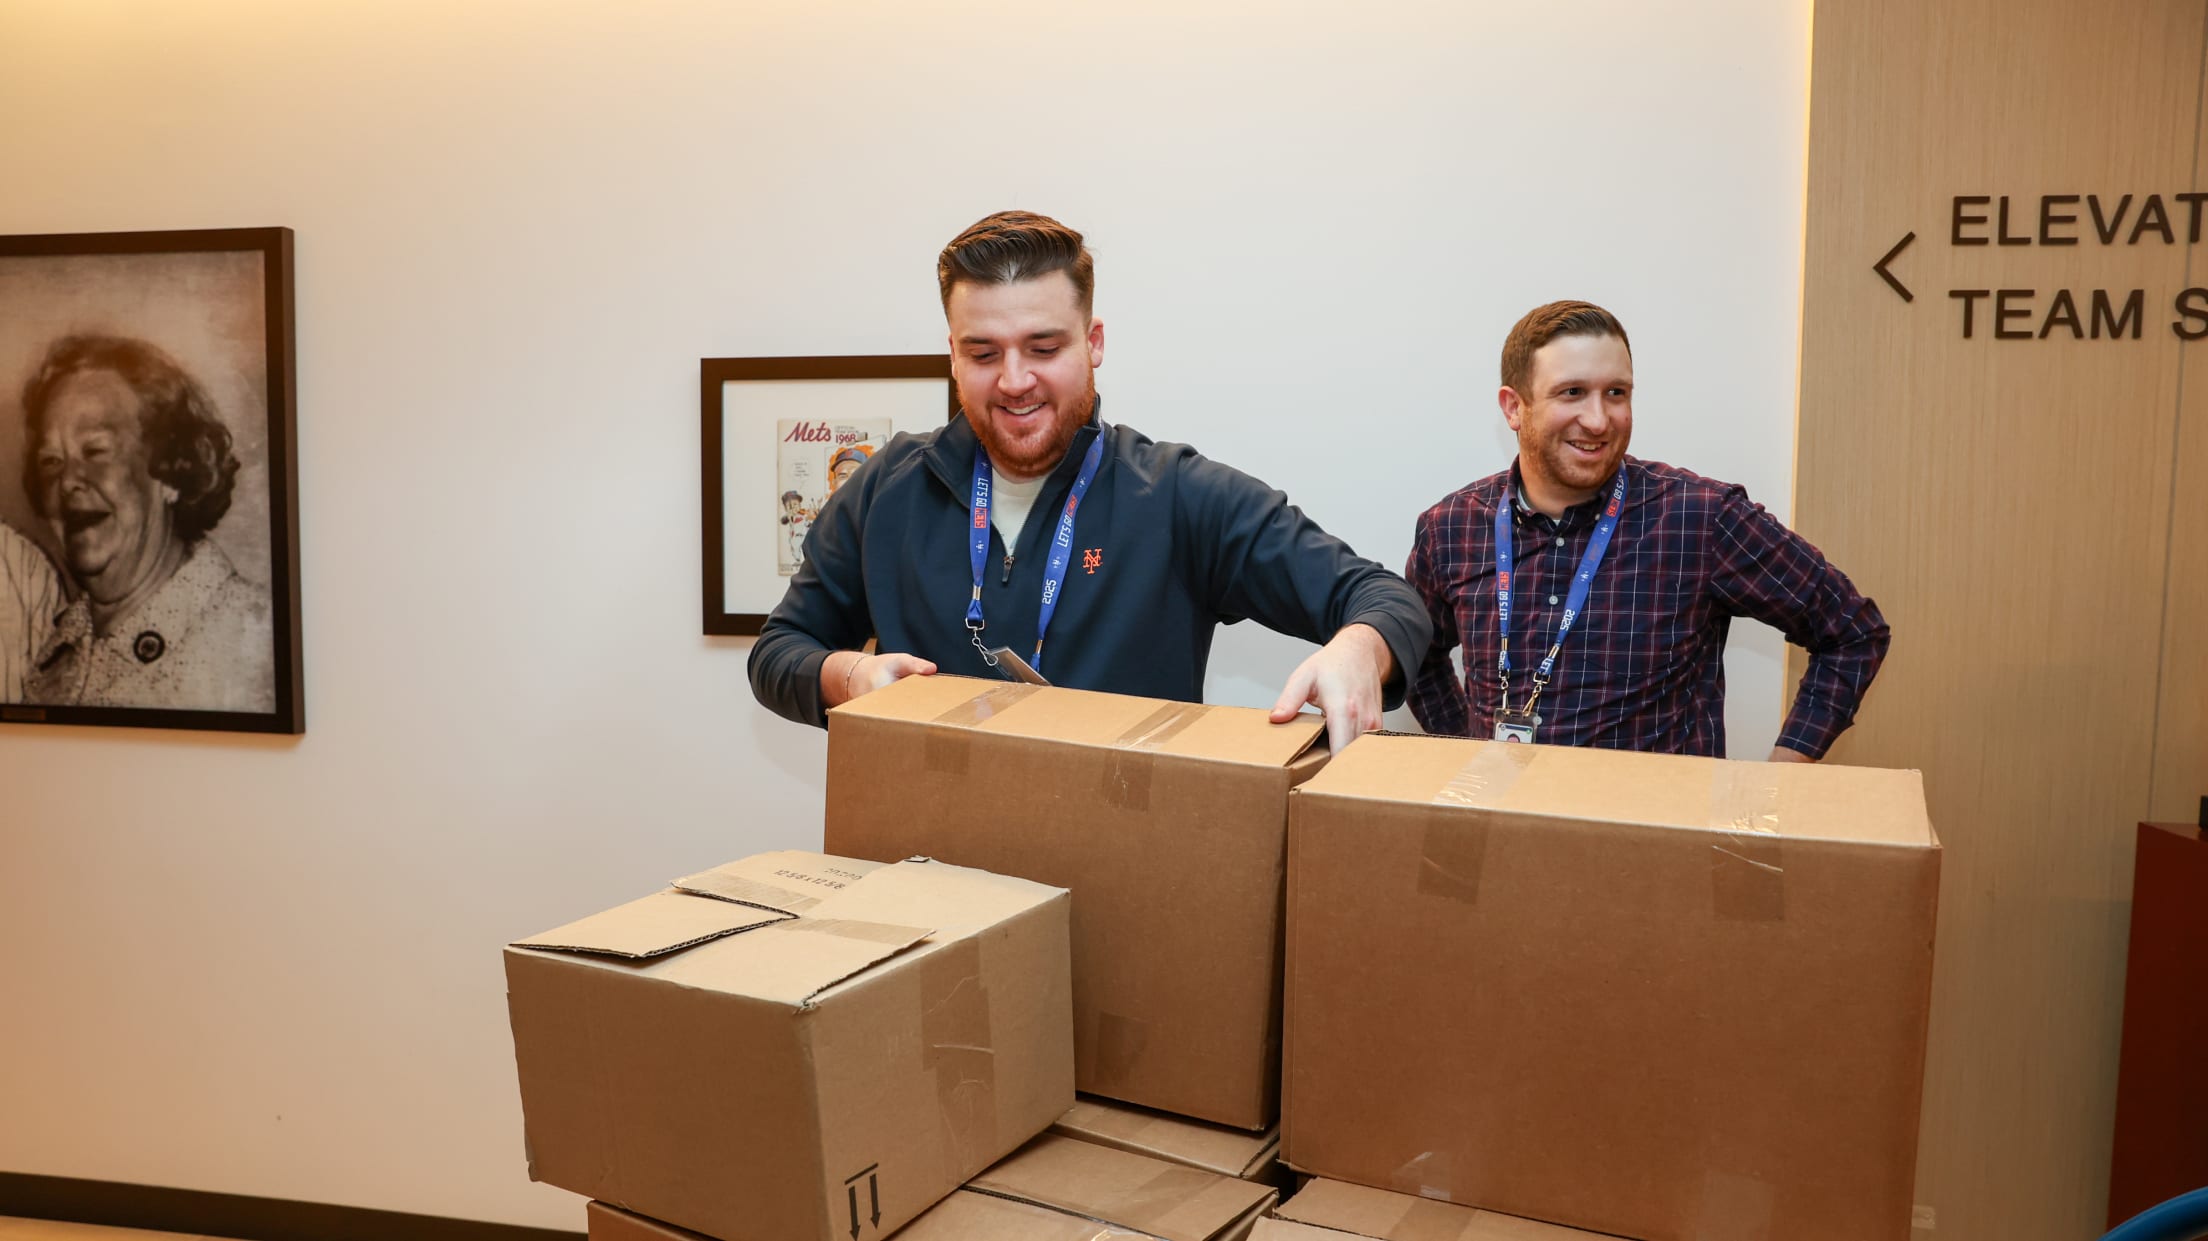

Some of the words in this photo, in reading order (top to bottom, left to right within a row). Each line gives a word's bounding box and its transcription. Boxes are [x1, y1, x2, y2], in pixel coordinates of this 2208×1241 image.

[1951, 193, 2208, 246] ELEVAT
[1948, 288, 2144, 340] TEAM
[2172, 287, 2208, 341] S
[784, 421, 832, 442] Mets
[976, 477, 989, 497] LET'S
[975, 497, 988, 507] GO
[1057, 524, 1071, 548] LET'S
[1042, 579, 1057, 605] 2025
[1560, 609, 1576, 631] 2025
